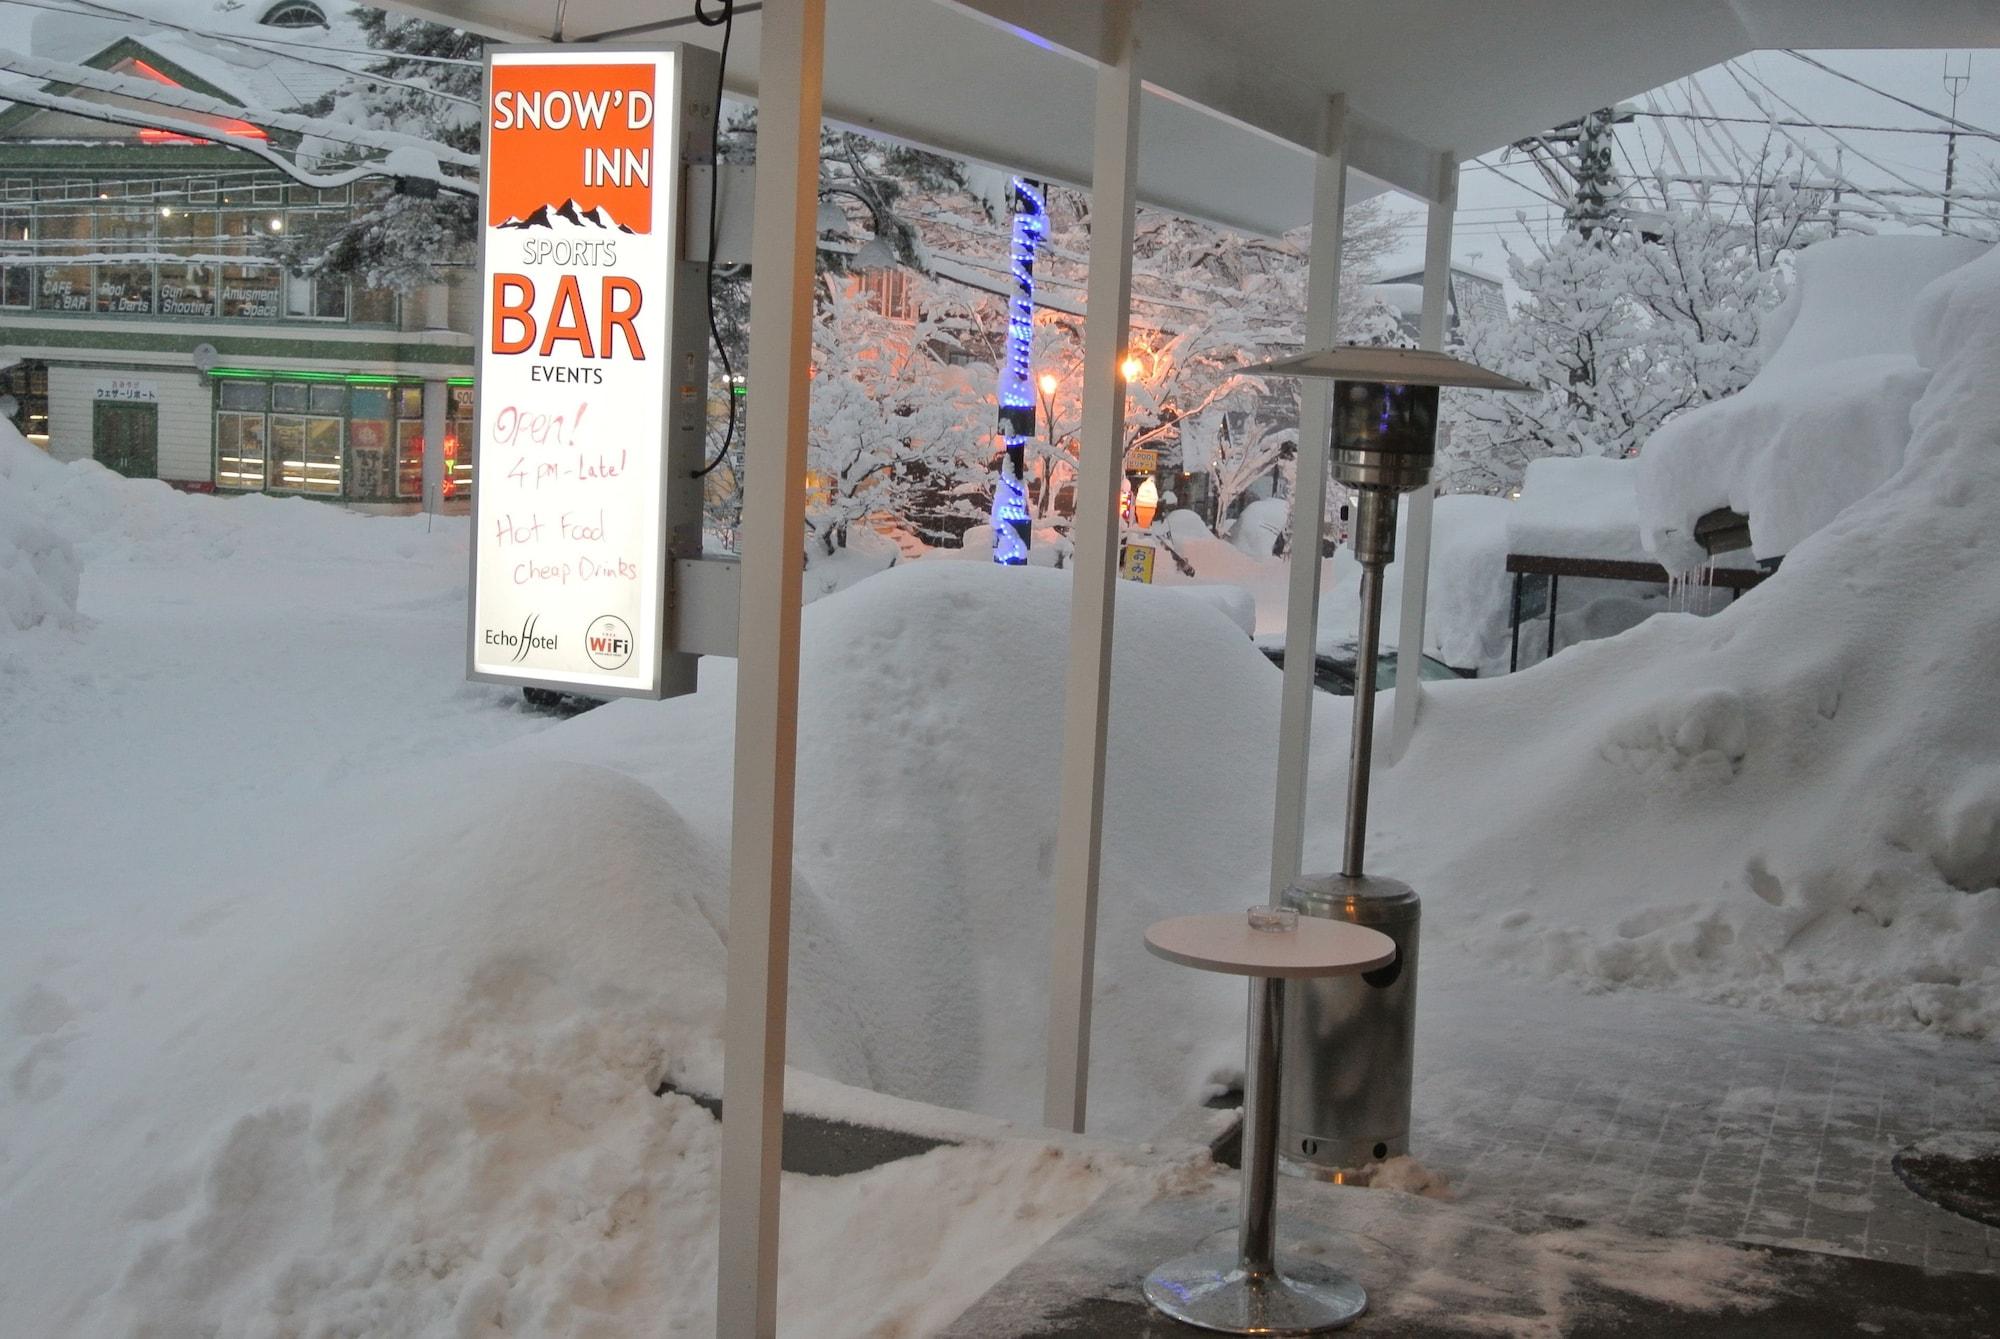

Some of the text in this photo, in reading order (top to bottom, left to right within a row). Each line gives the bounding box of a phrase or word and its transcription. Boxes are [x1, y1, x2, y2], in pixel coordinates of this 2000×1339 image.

[584, 148, 650, 188] INN
[522, 238, 617, 267] SPORTS
[43, 280, 73, 295] CAFE
[101, 282, 126, 296] Pool
[161, 284, 183, 298] Gun
[64, 296, 88, 310] BAR
[118, 298, 149, 311] Darts
[163, 299, 213, 316] Shooting
[243, 304, 278, 317] Space
[491, 273, 646, 361] BAR
[531, 365, 603, 384] EVENTS
[496, 508, 606, 547] Hot Food
[514, 556, 637, 584] Cheap Drinks
[590, 637, 630, 655] WiFi
